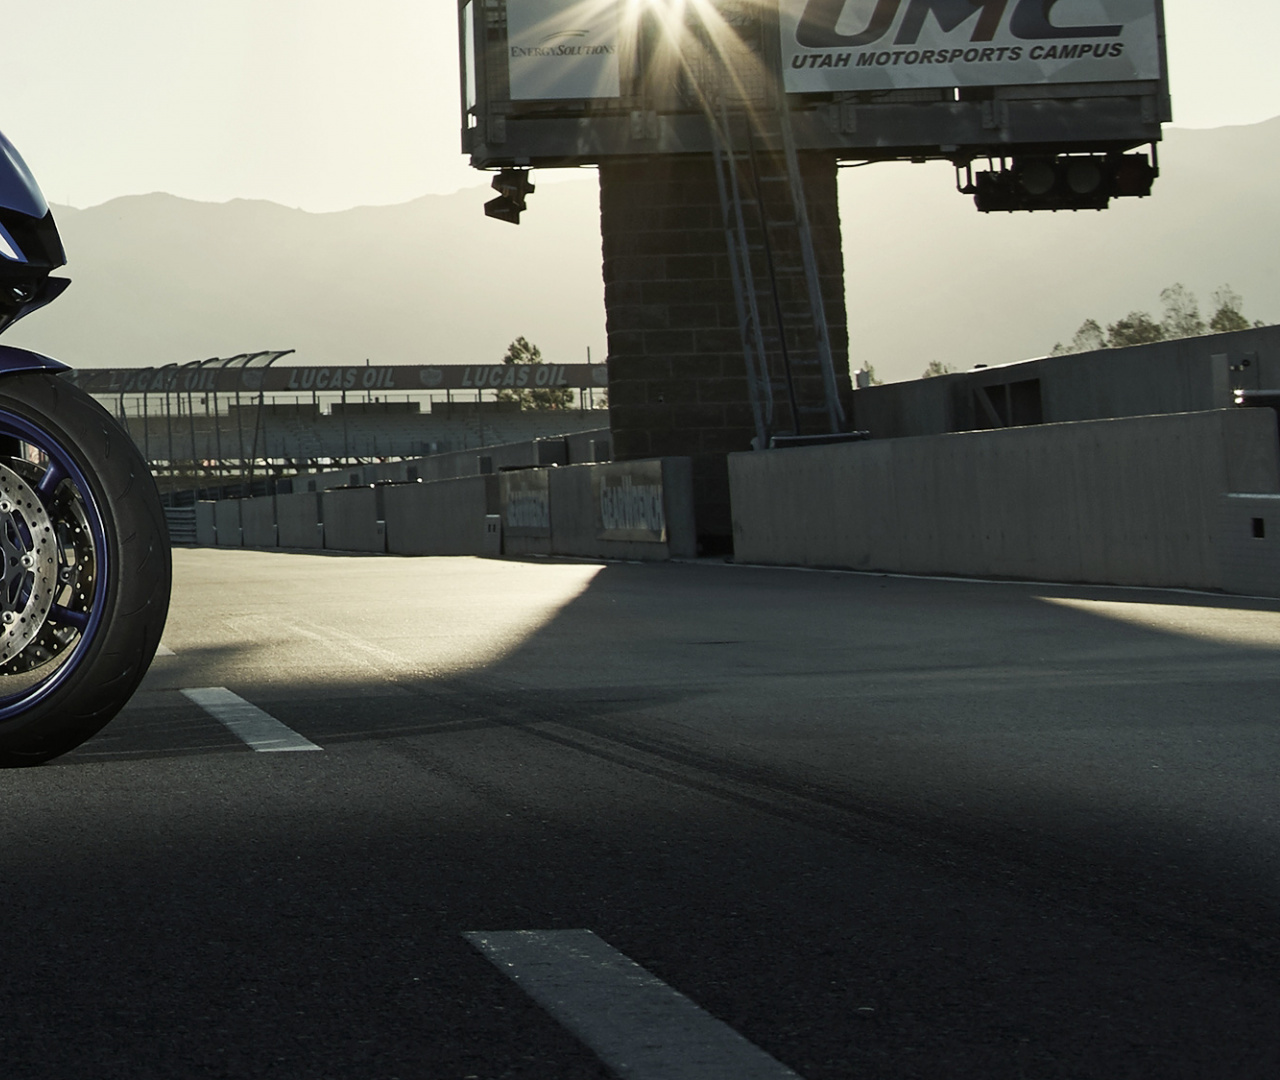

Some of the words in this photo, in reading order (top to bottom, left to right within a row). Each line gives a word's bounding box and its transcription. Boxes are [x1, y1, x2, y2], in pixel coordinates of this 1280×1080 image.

[791, 52, 852, 70] UTAH
[855, 46, 1022, 67] MOTORSPORTS
[1028, 42, 1124, 61] CAMPUS
[184, 369, 216, 390] OIL
[288, 369, 357, 390] LUCAS
[362, 368, 395, 388] OIL
[461, 367, 531, 387] LUCAS
[535, 366, 568, 386] OIL
